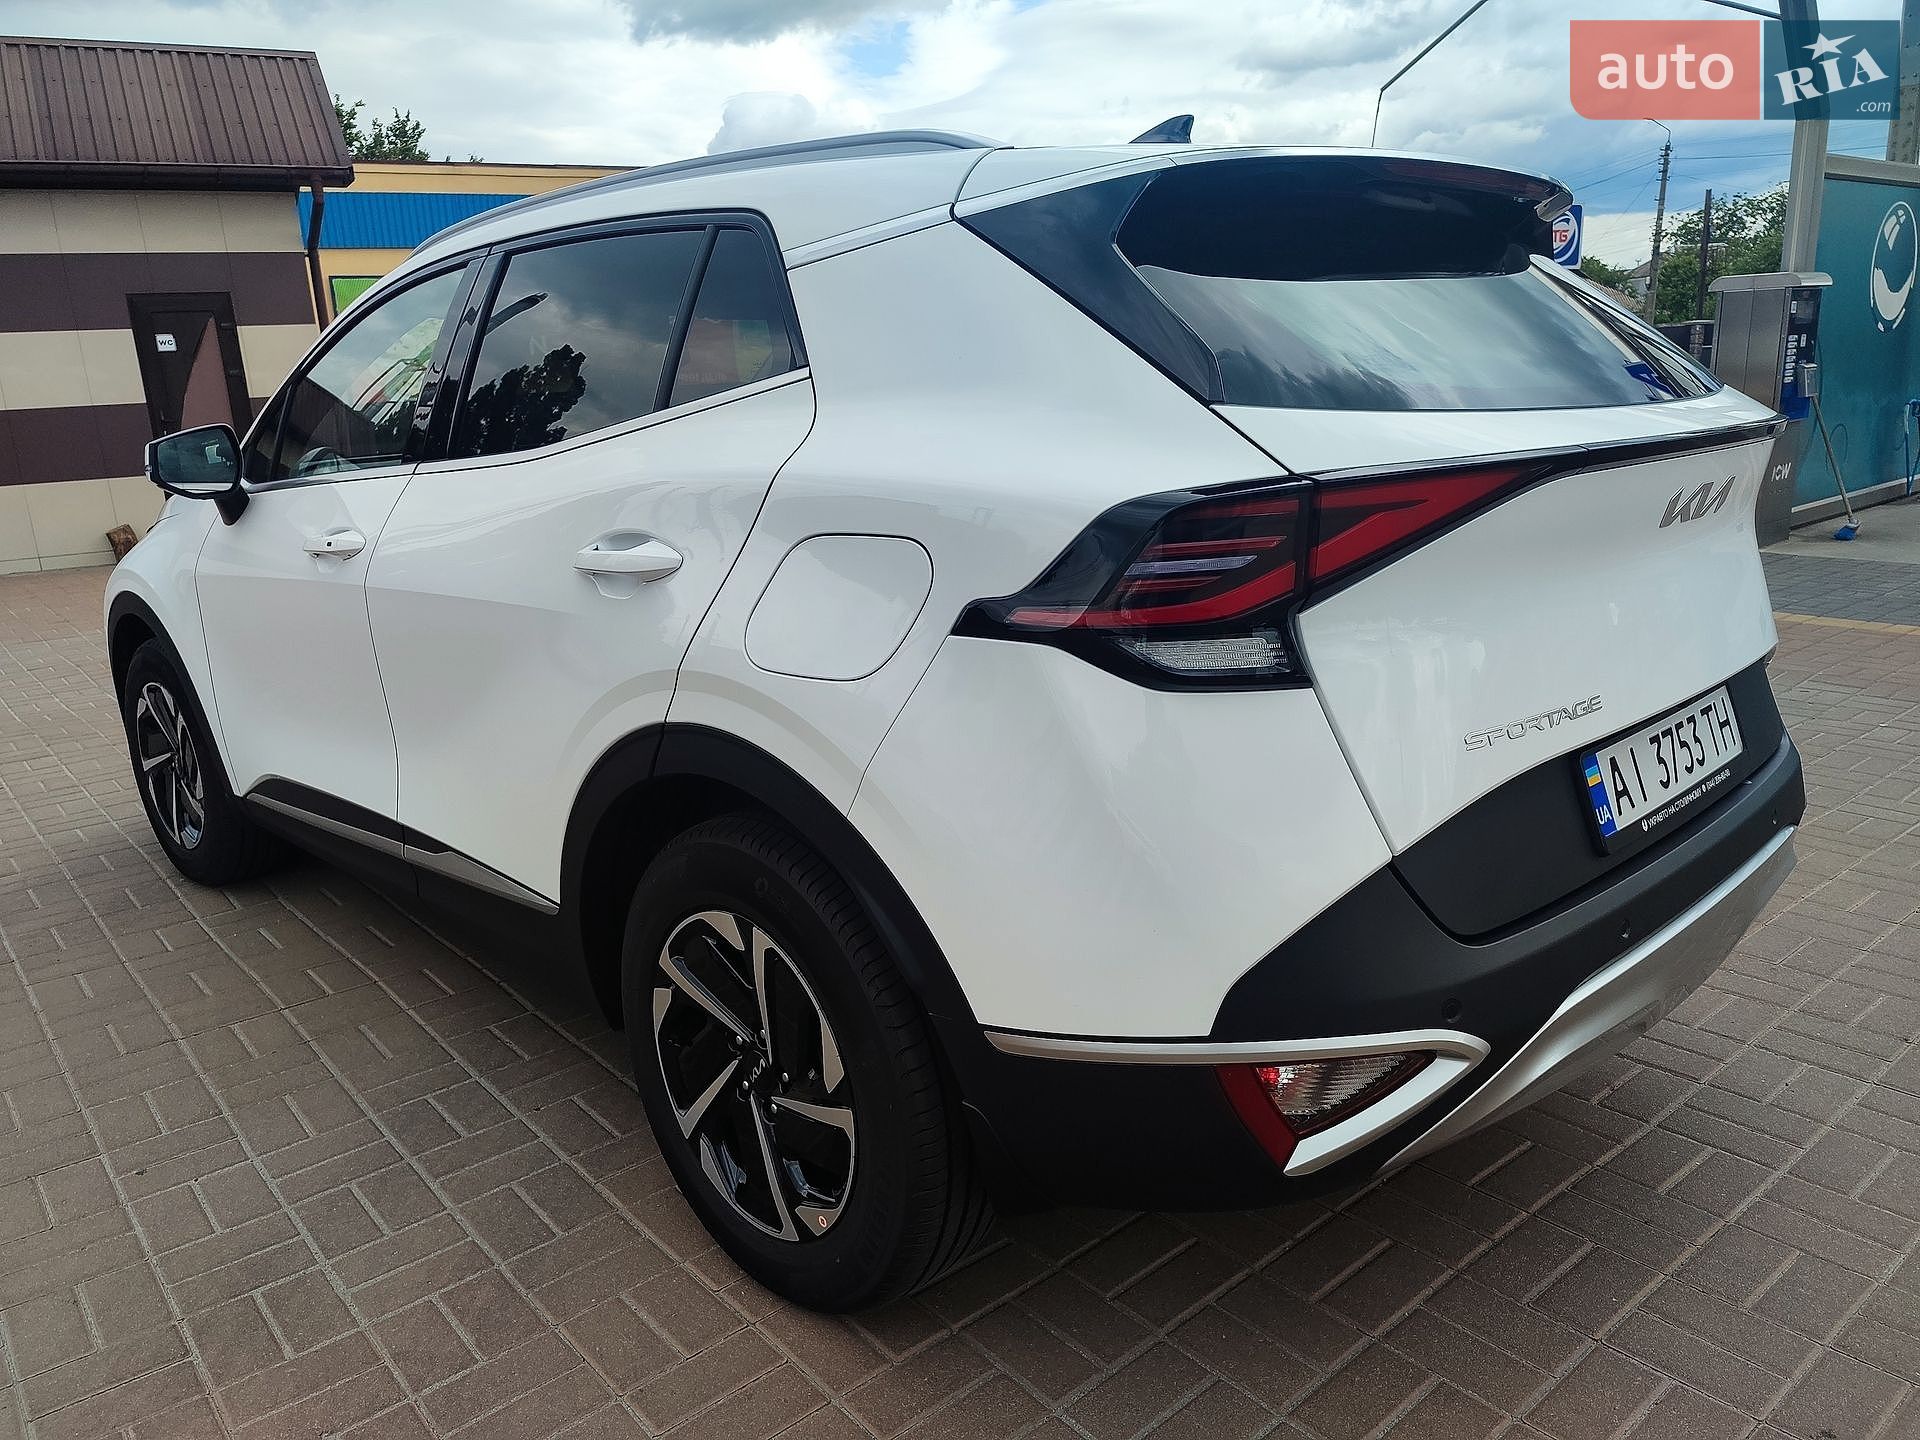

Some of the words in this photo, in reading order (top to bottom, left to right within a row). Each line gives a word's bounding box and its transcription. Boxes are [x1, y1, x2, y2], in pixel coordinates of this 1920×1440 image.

[1659, 475, 1737, 528] KIA
[1464, 694, 1602, 751] SPORTAGE
[1609, 747, 1648, 816] AI
[1649, 714, 1706, 789] 3753
[1700, 696, 1736, 756] TH
[1596, 804, 1612, 825] UA
